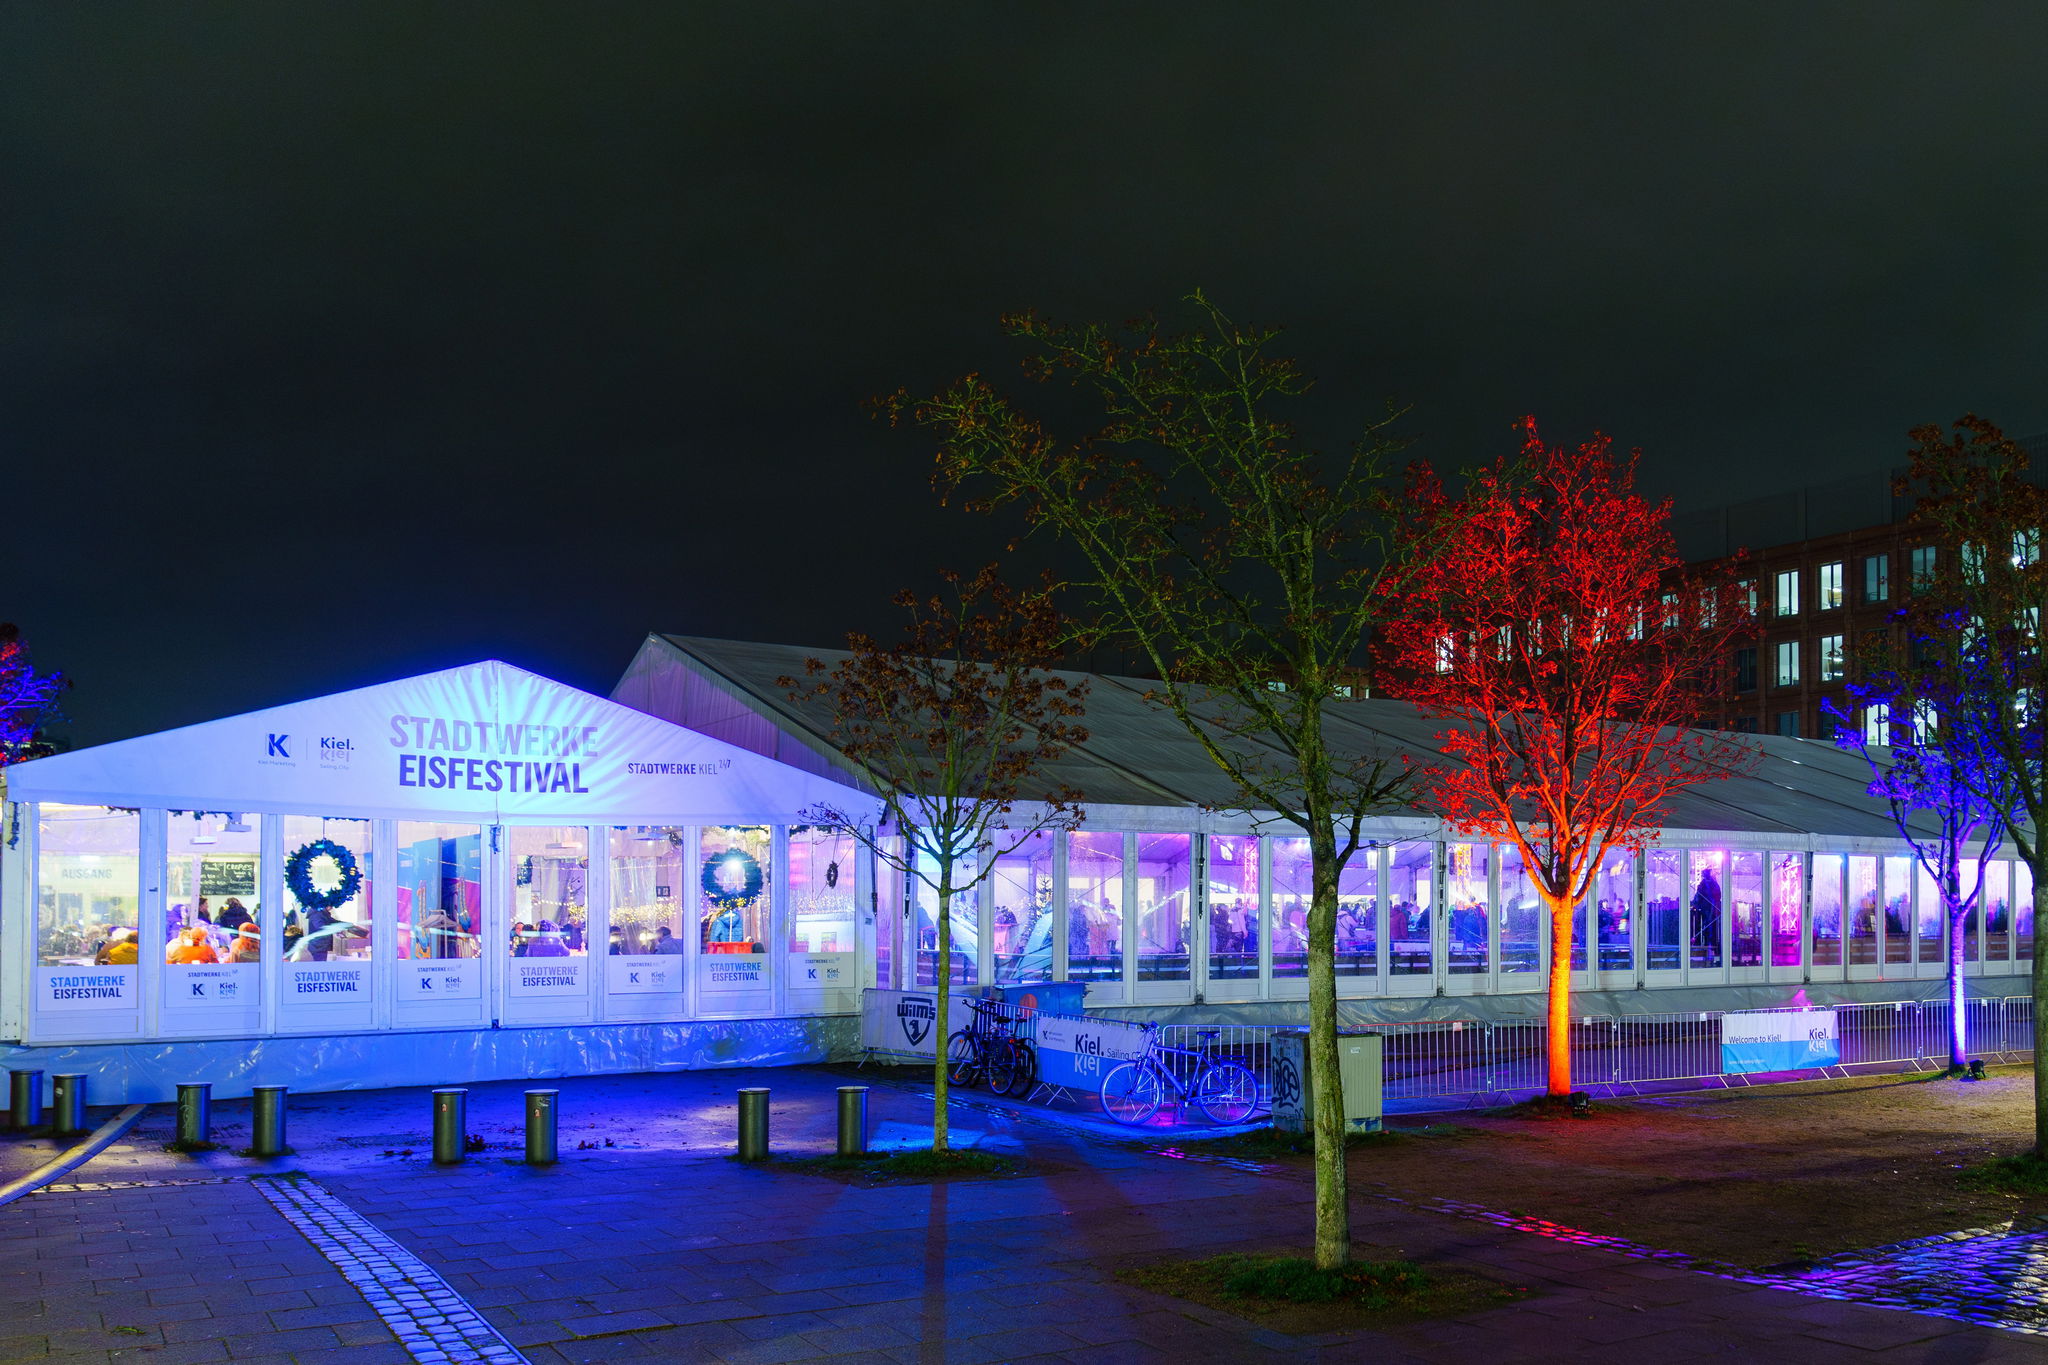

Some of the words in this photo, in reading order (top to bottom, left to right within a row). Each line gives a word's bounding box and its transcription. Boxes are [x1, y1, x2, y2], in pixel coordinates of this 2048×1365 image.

[389, 714, 598, 757] STADTWERKE
[268, 733, 290, 758] K
[320, 736, 355, 750] Kiel.
[399, 754, 589, 793] EISFESTIVAL
[628, 763, 696, 774] STADTWERKE
[699, 764, 718, 775] KIEL
[520, 965, 578, 976] STADTWERKE
[710, 962, 762, 972] STADTWERKE
[294, 970, 361, 982] STADTWERKE
[630, 972, 640, 983] K
[711, 972, 760, 981] EISFESTIVAL
[808, 969, 816, 979] K
[50, 975, 126, 988] STADTWERKE
[421, 977, 432, 989] K
[522, 976, 576, 986] EISFESTIVAL
[54, 987, 122, 999] EISFESTIVAL
[192, 983, 205, 996] K
[297, 982, 358, 993] EISFESTIVAL
[1728, 1036, 1758, 1044] Welcome
[1759, 1035, 1766, 1043] to
[1767, 1034, 1782, 1042] Kiel!
[1809, 1028, 1829, 1040] Kiel.
[1075, 1033, 1105, 1056] Kiel.
[1107, 1047, 1130, 1060] Sailing
